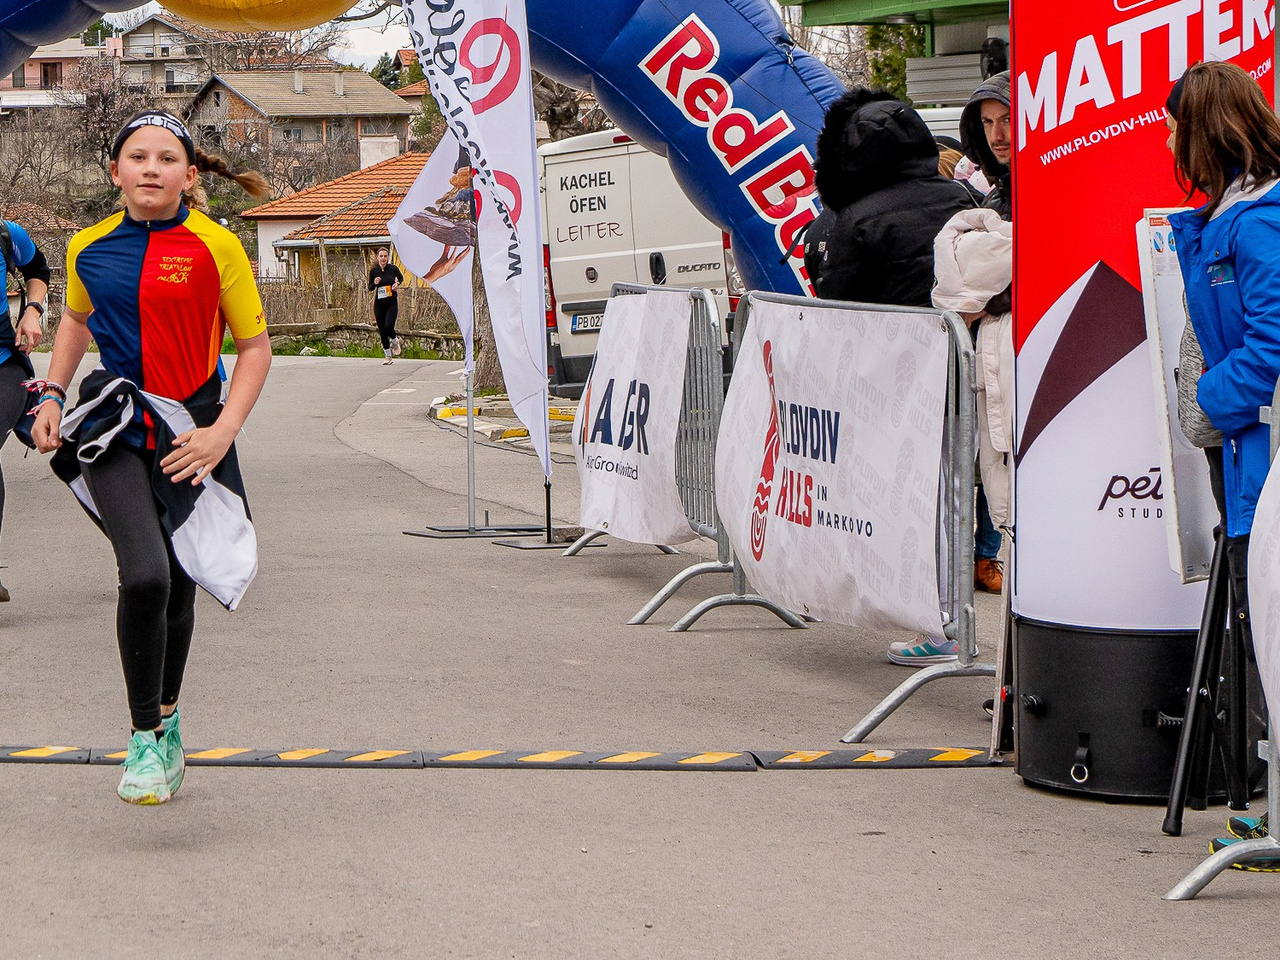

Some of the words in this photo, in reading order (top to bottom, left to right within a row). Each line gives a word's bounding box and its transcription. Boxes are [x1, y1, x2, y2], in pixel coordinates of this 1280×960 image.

[641, 17, 792, 171] Red
[744, 148, 818, 298] Bu
[559, 170, 616, 191] KACHEL
[569, 195, 607, 214] ÖFEN
[556, 221, 624, 244] LEITER
[677, 262, 721, 274] DUCATO
[778, 399, 841, 464] PLOVDIV
[816, 484, 828, 502] IN
[1118, 507, 1163, 518] STUD
[816, 509, 873, 538] MARKOVO
